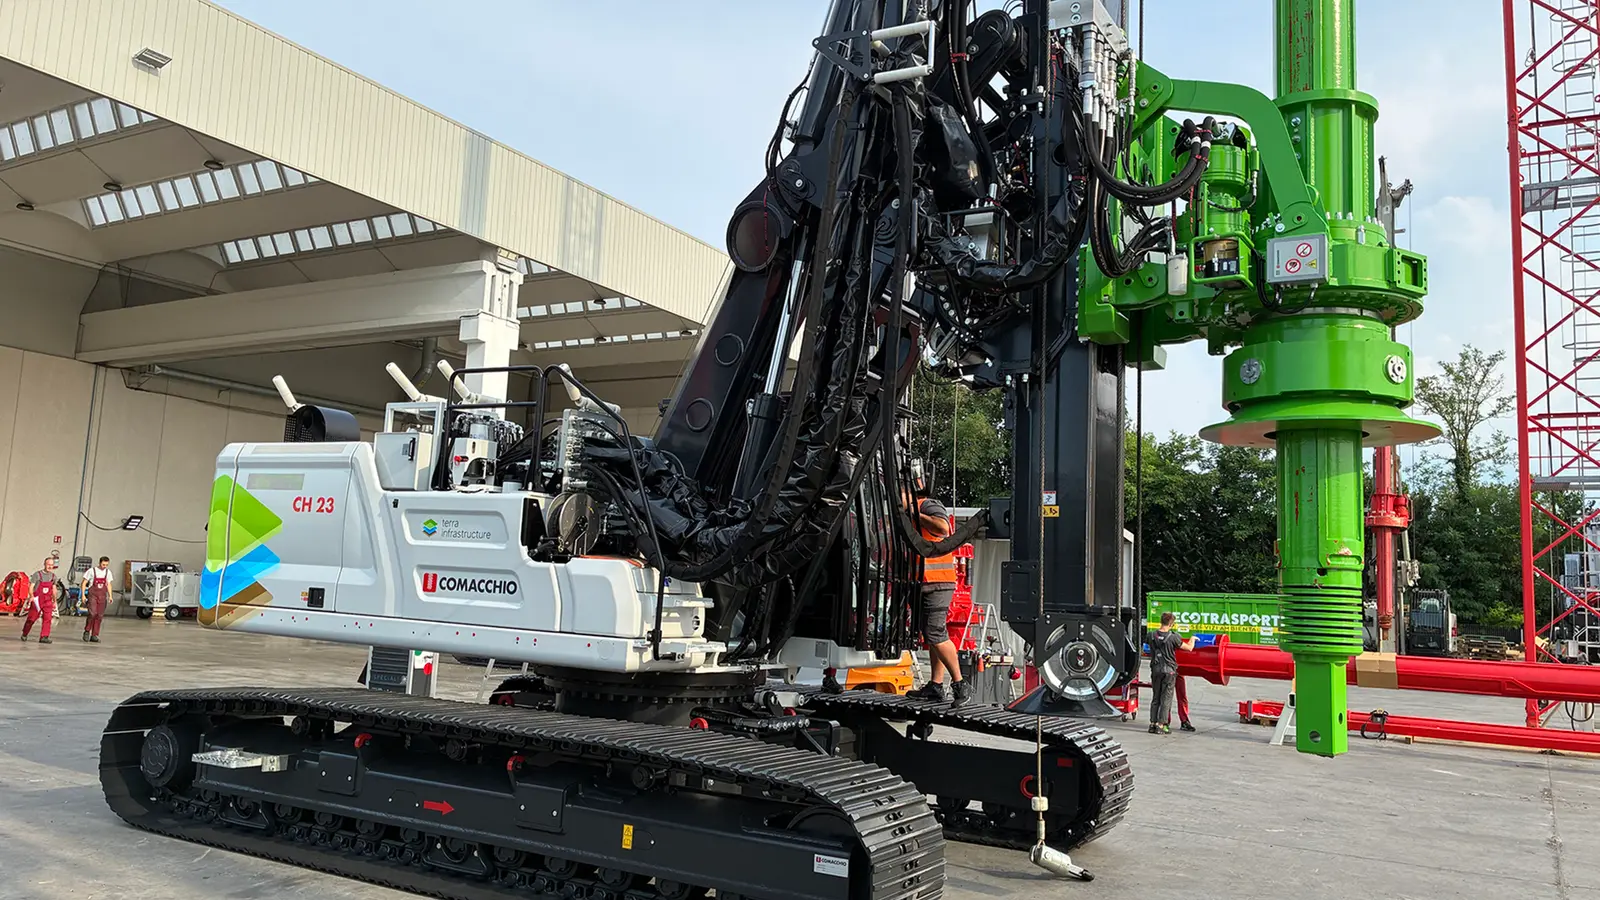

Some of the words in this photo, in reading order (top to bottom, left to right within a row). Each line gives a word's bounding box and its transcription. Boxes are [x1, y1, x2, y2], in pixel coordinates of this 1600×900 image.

[292, 496, 313, 513] CH
[316, 496, 335, 514] 23
[441, 519, 460, 528] terra
[441, 529, 492, 540] infrastructure
[439, 576, 518, 595] COMACCHIO
